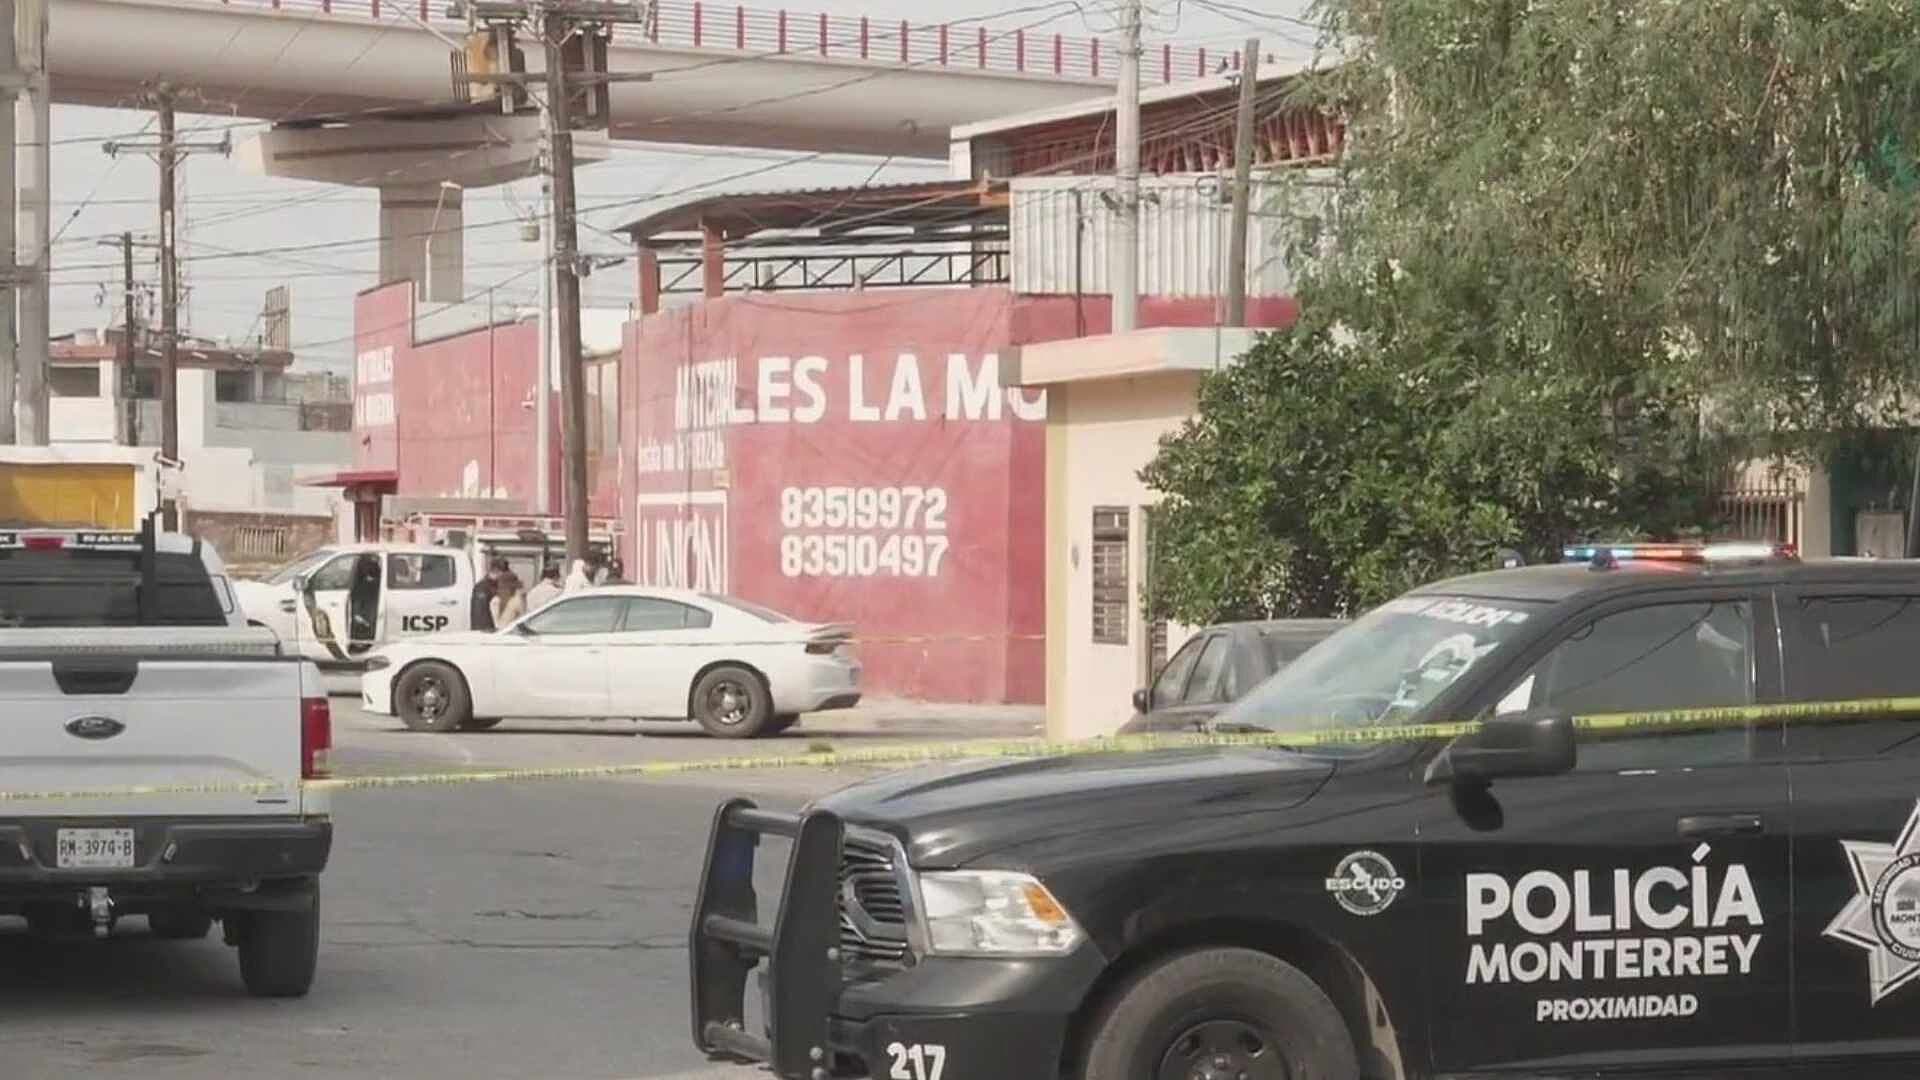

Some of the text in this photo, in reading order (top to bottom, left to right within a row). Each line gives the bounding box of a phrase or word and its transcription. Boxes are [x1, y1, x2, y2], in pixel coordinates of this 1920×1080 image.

[850, 354, 926, 421] LA
[780, 486, 947, 530] 83519972
[780, 535, 949, 577] 83510497
[402, 615, 449, 632] ICSP
[1326, 878, 1405, 890] ESCUDO
[1466, 842, 1764, 936] POLICÍA
[1466, 934, 1762, 984] MONTERREY
[1536, 995, 1698, 1022] PROXIMIDAD
[886, 1042, 946, 1080] 217
